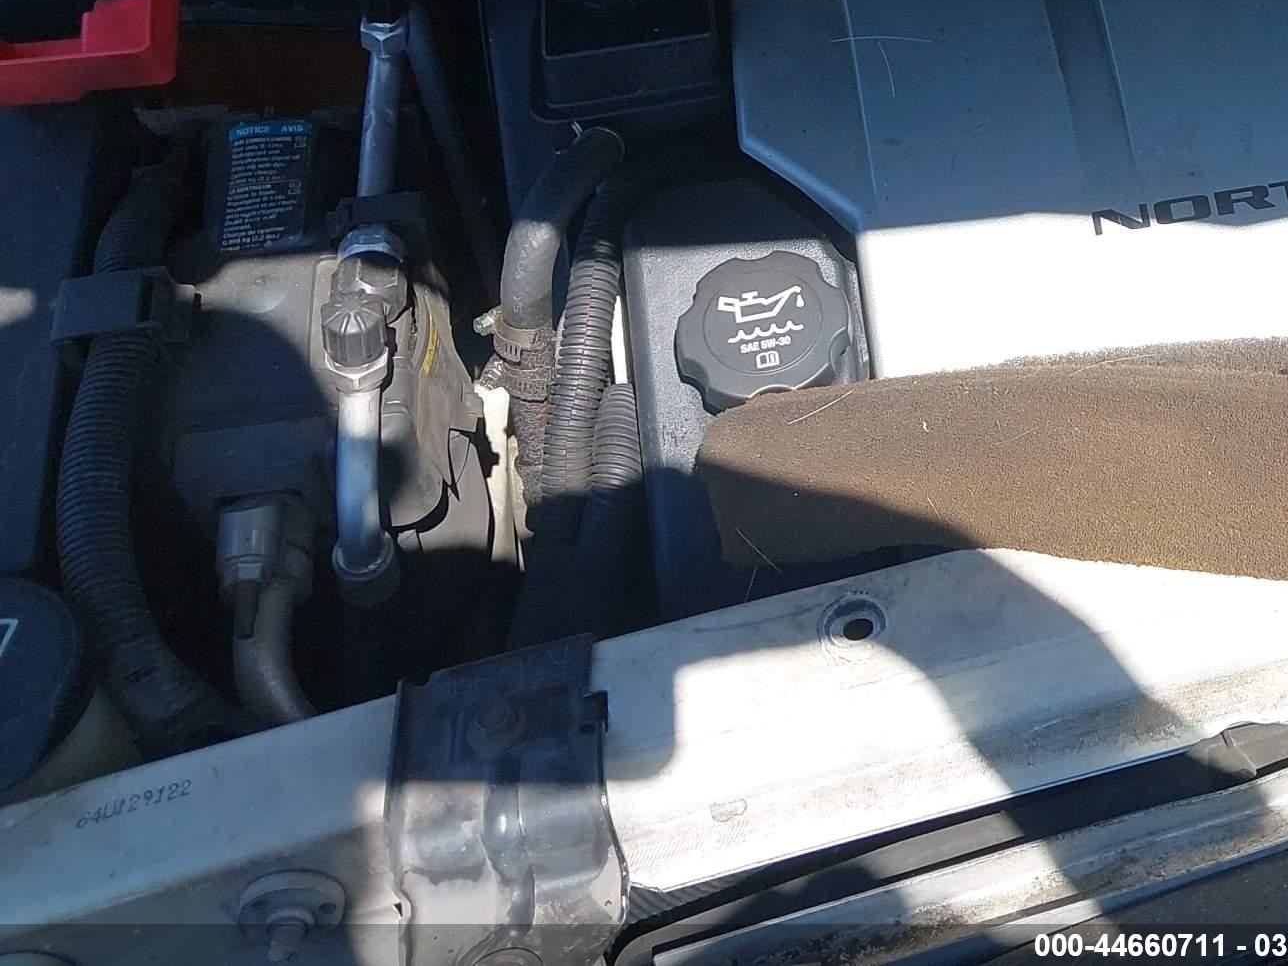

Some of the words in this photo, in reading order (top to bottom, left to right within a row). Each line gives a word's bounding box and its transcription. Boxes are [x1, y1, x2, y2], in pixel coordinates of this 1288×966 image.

[236, 125, 270, 135] NOTICE
[281, 124, 304, 133] AVIS
[740, 341, 760, 353] SAE
[760, 335, 791, 349] 5W-30
